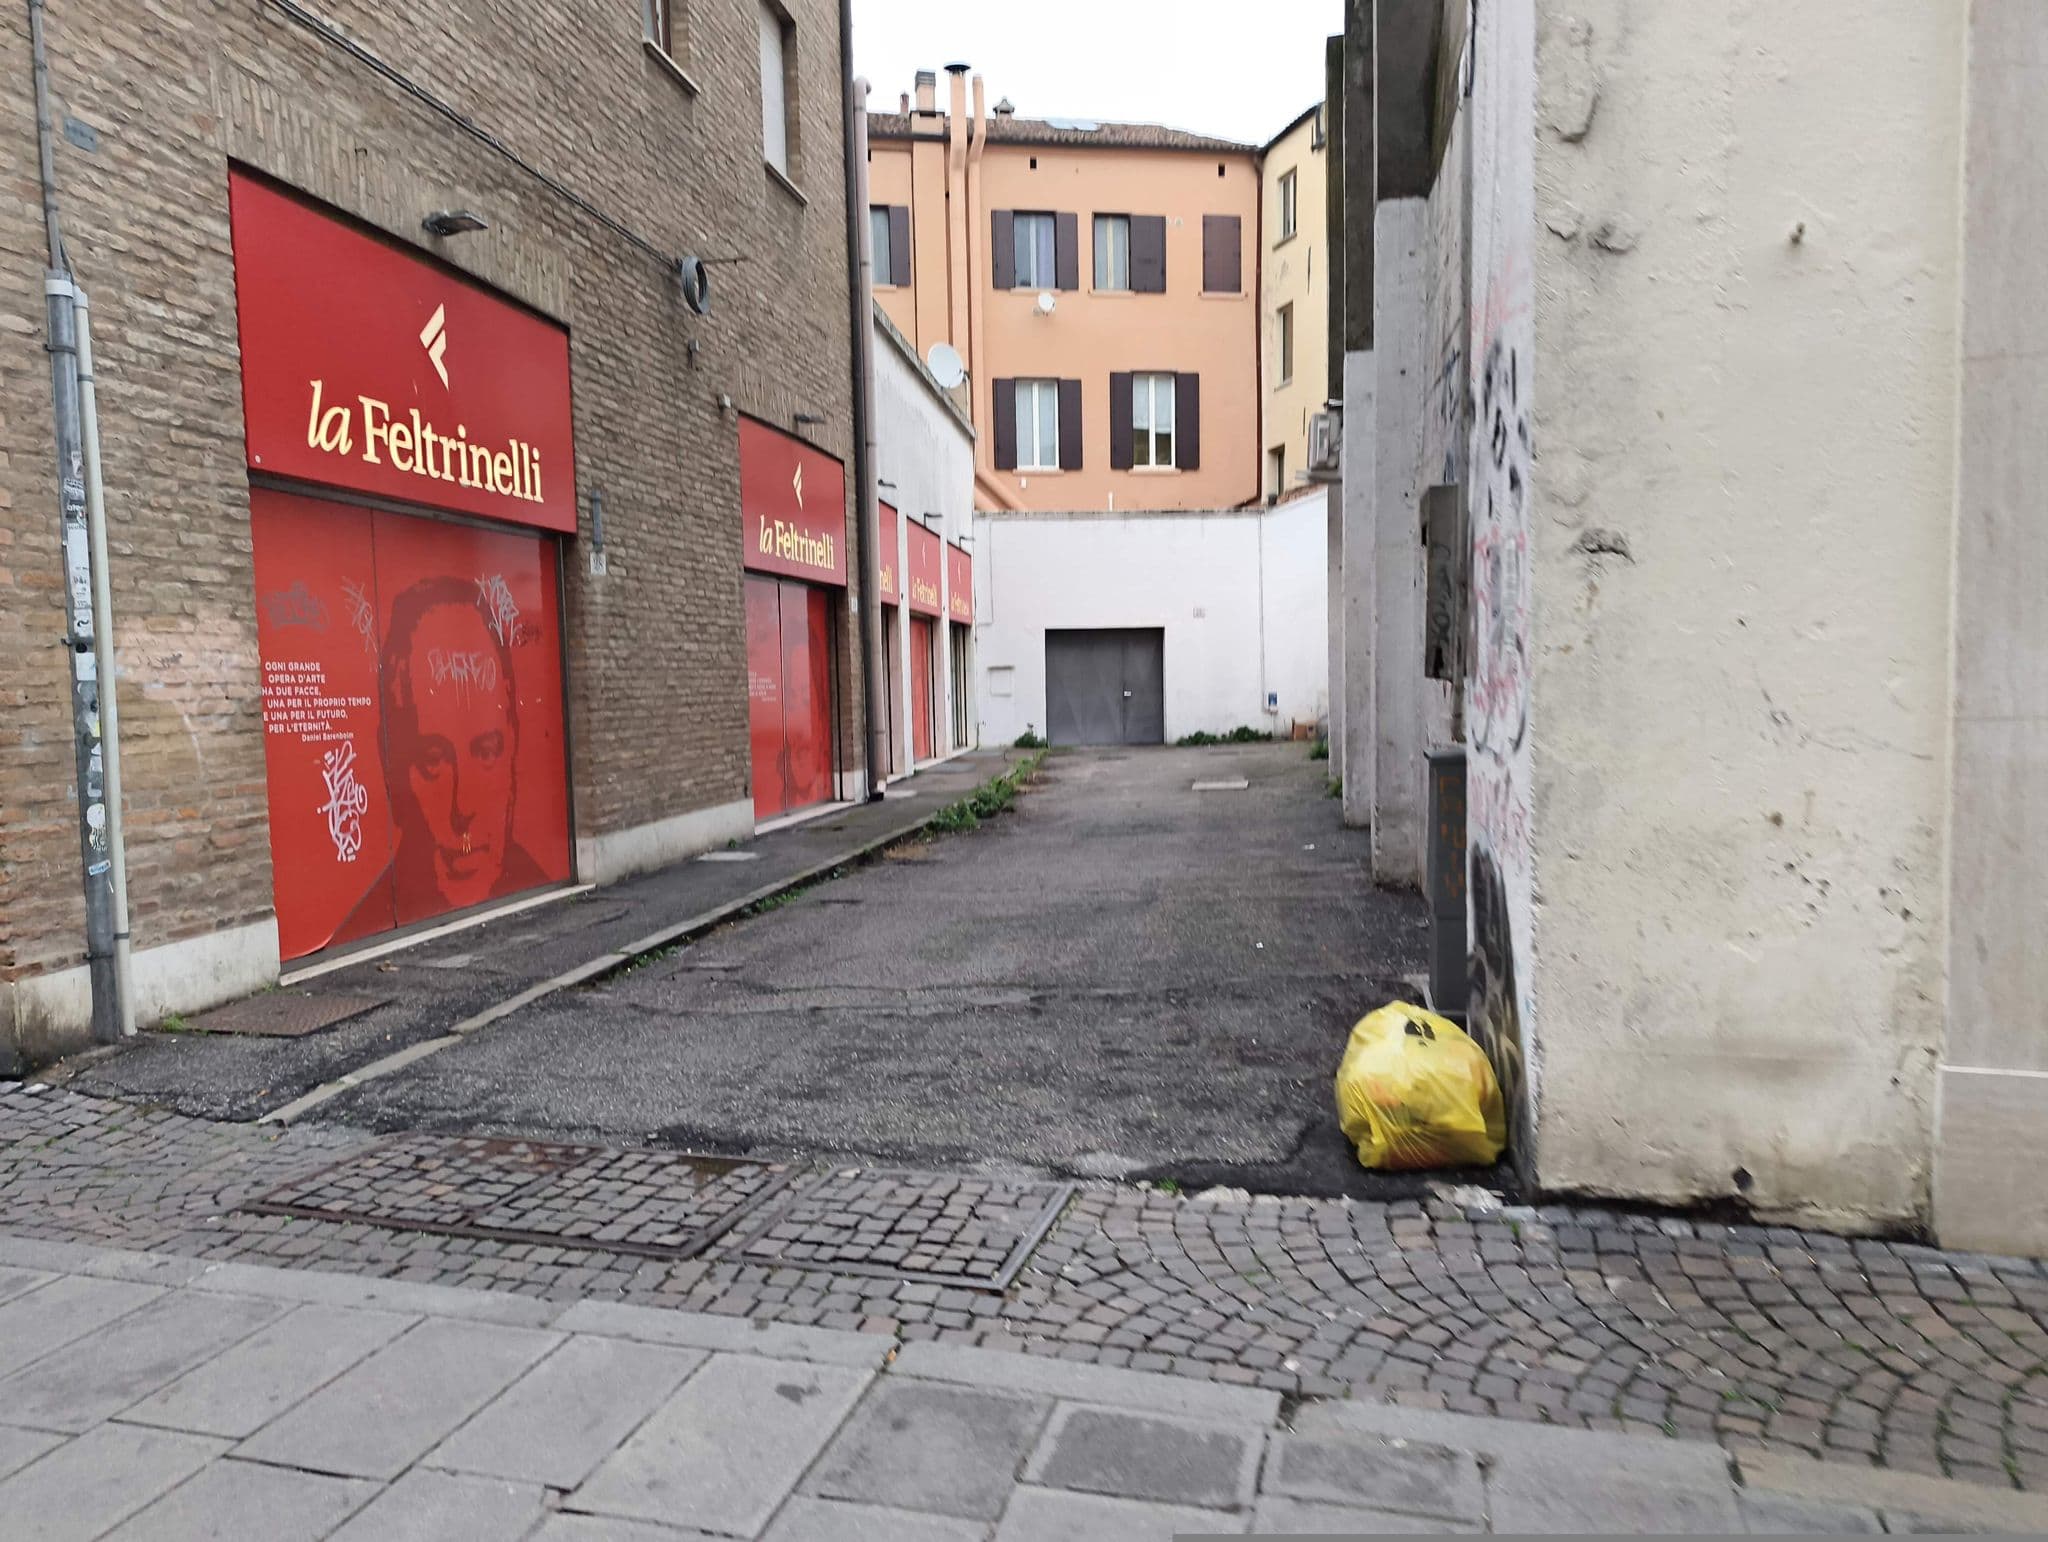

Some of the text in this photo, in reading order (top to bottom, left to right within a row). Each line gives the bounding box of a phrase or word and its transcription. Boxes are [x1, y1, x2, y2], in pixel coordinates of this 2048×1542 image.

[307, 379, 544, 504] la Feltrinelli
[759, 514, 834, 570] la Feltrinelli
[265, 661, 320, 672] OGNI GRANDE
[268, 674, 326, 684] OPERA D'ARTE
[276, 686, 292, 696] DUE
[294, 686, 321, 696] FACCE,
[267, 697, 372, 709] UNA PER IL PROPRIO TEMPO
[263, 709, 349, 722] E UNA PER IL FUTURO,
[269, 723, 285, 734] PER
[301, 733, 322, 743] Daniel
